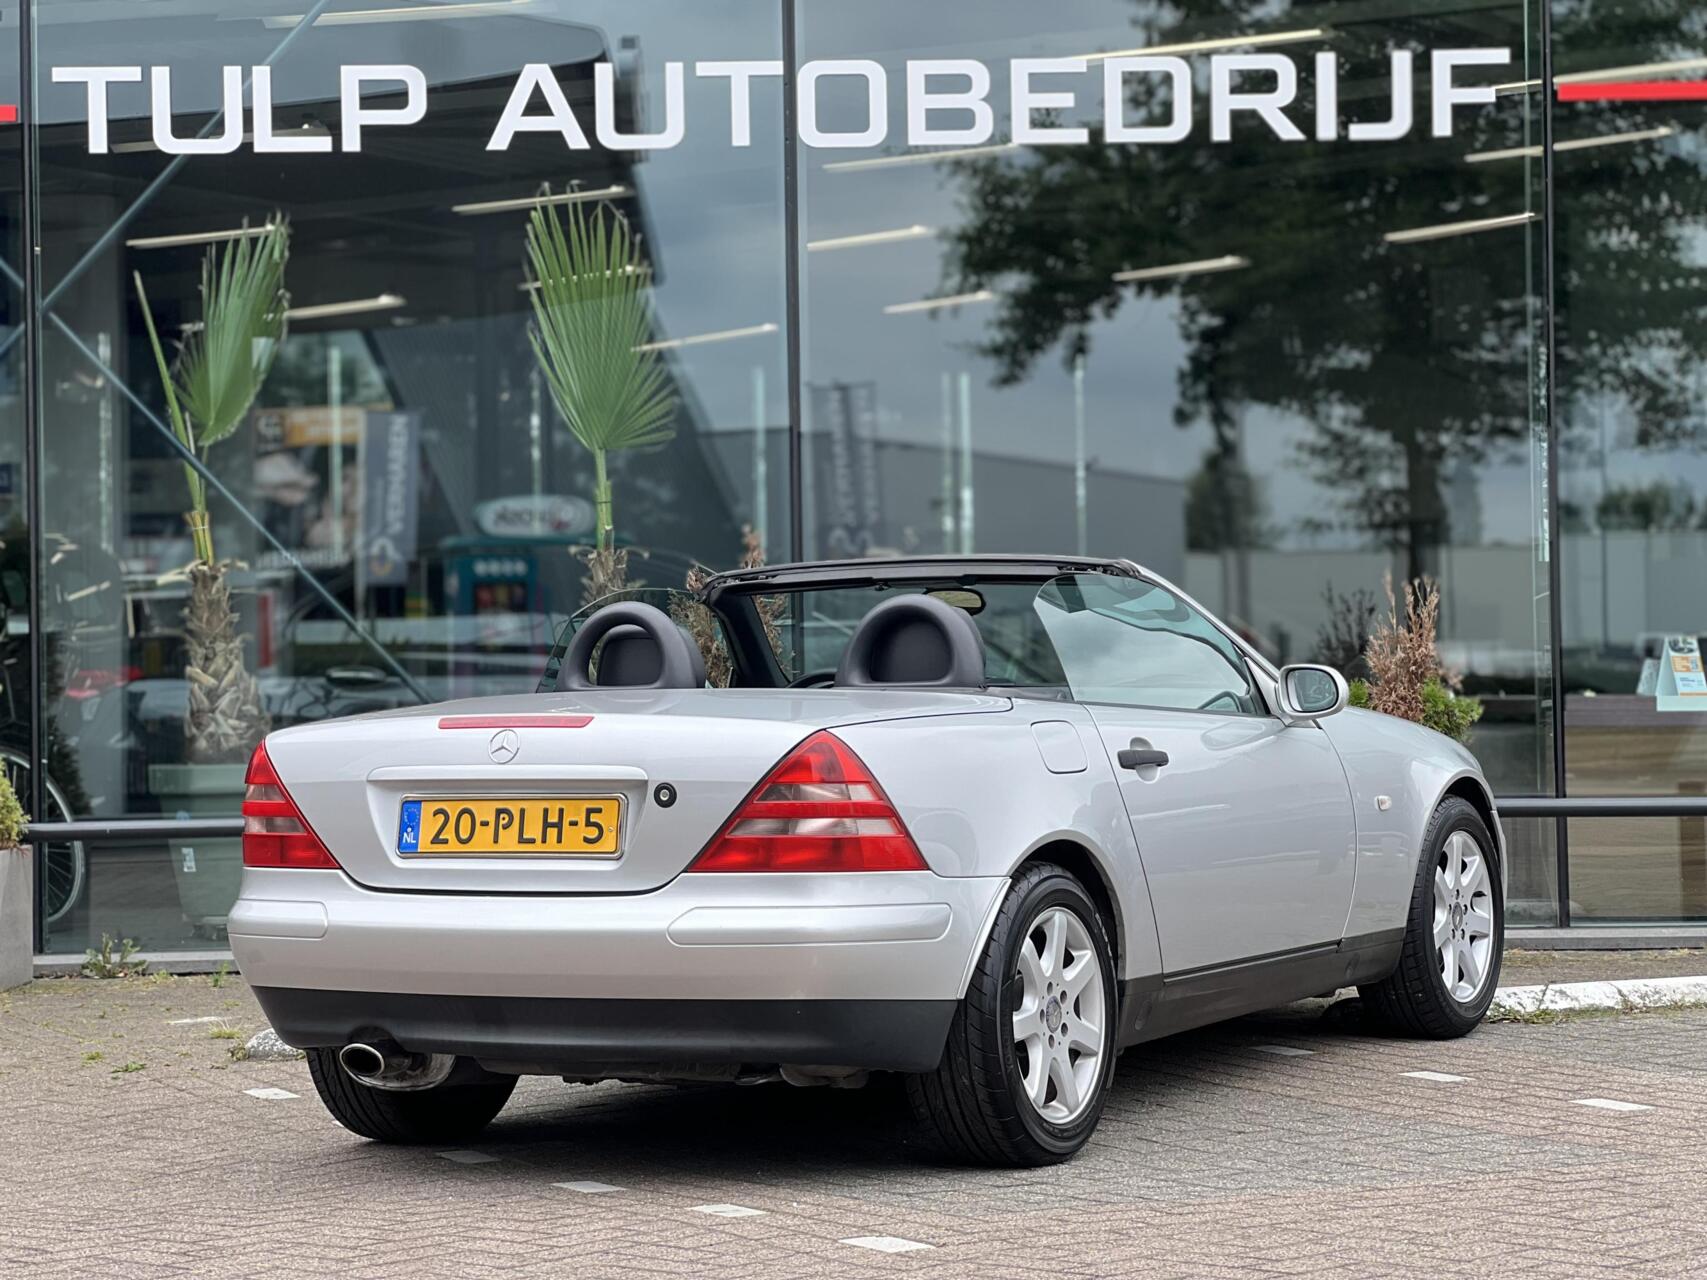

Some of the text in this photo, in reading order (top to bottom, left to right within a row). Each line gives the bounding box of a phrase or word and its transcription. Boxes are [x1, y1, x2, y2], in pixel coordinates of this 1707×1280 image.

[51, 47, 1511, 154] TULP AUTOBEDRIJF
[402, 831, 417, 843] NL
[430, 807, 605, 845] 20-PLH-5
